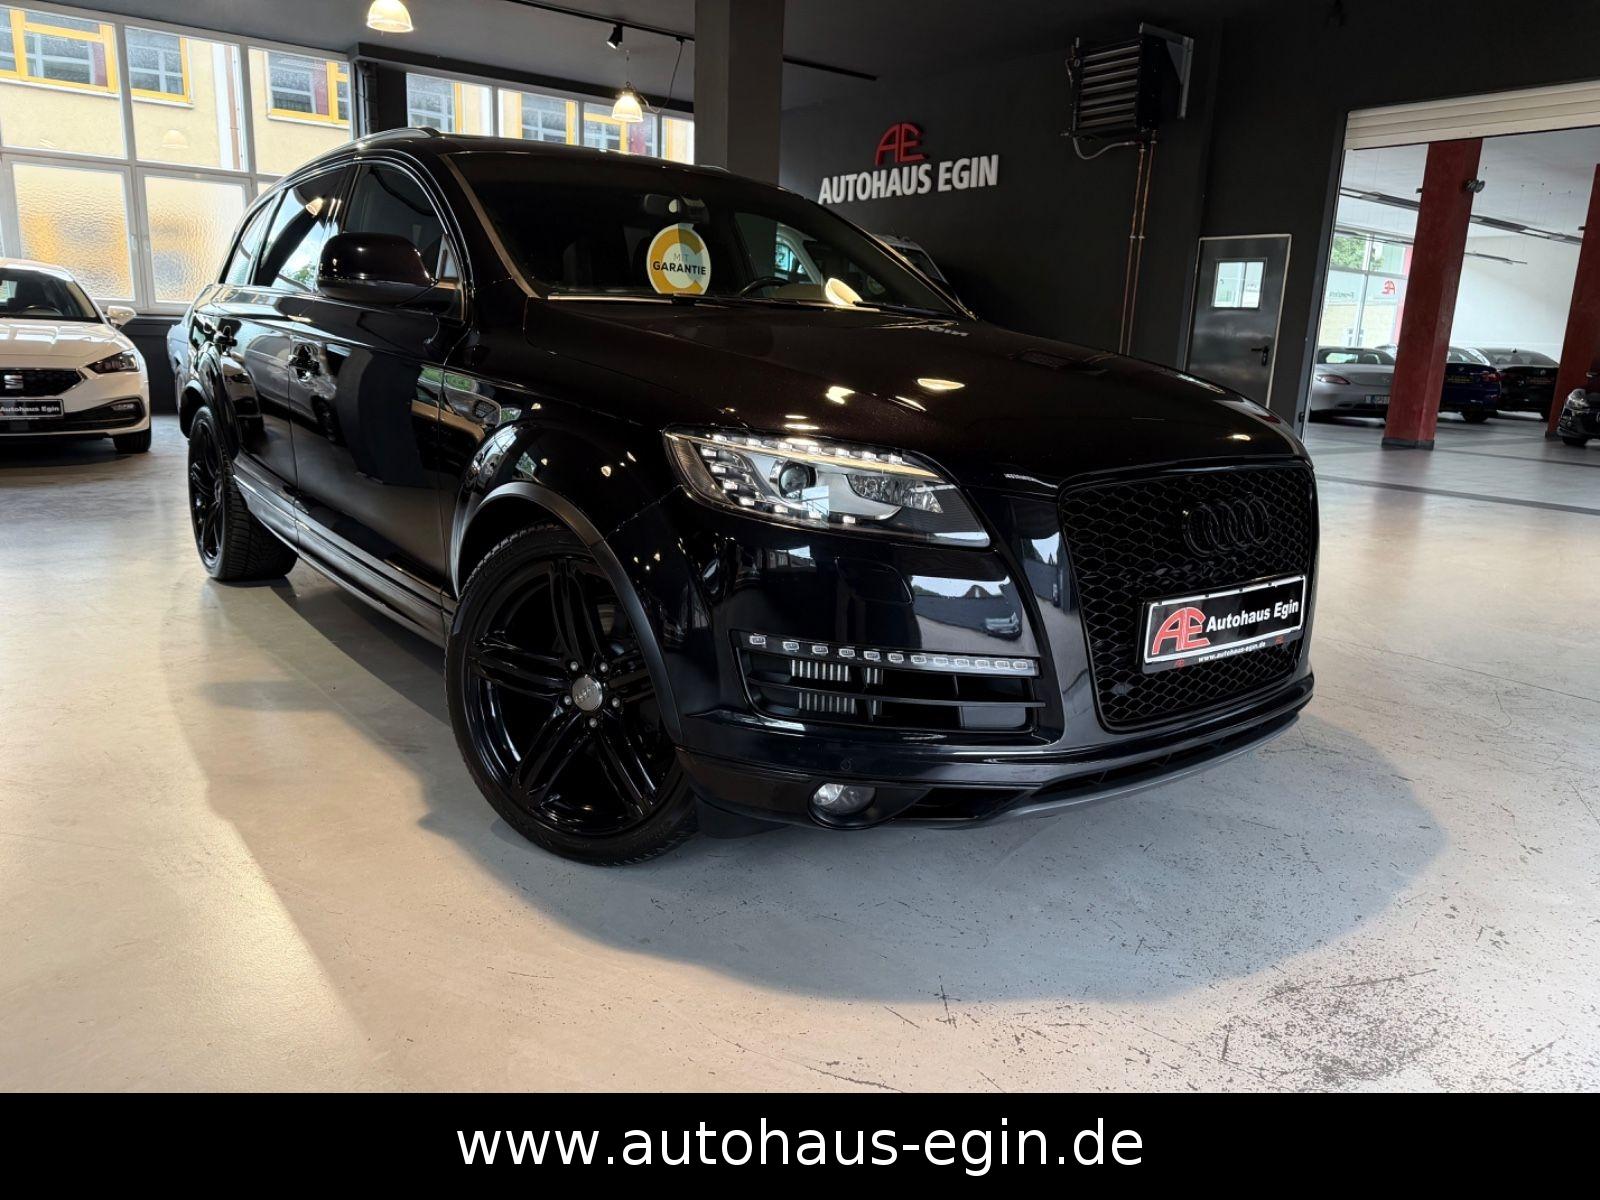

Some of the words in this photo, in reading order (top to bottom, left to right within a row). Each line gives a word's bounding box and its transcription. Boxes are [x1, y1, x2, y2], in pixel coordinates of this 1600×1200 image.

[818, 164, 932, 205] AUTOHAUS
[938, 154, 999, 192] EGIN
[653, 261, 707, 275] GARANTIE
[1206, 608, 1270, 633] Autohaus
[1273, 600, 1299, 619] Egin
[1198, 641, 1266, 662] www.autohaus-egin.de
